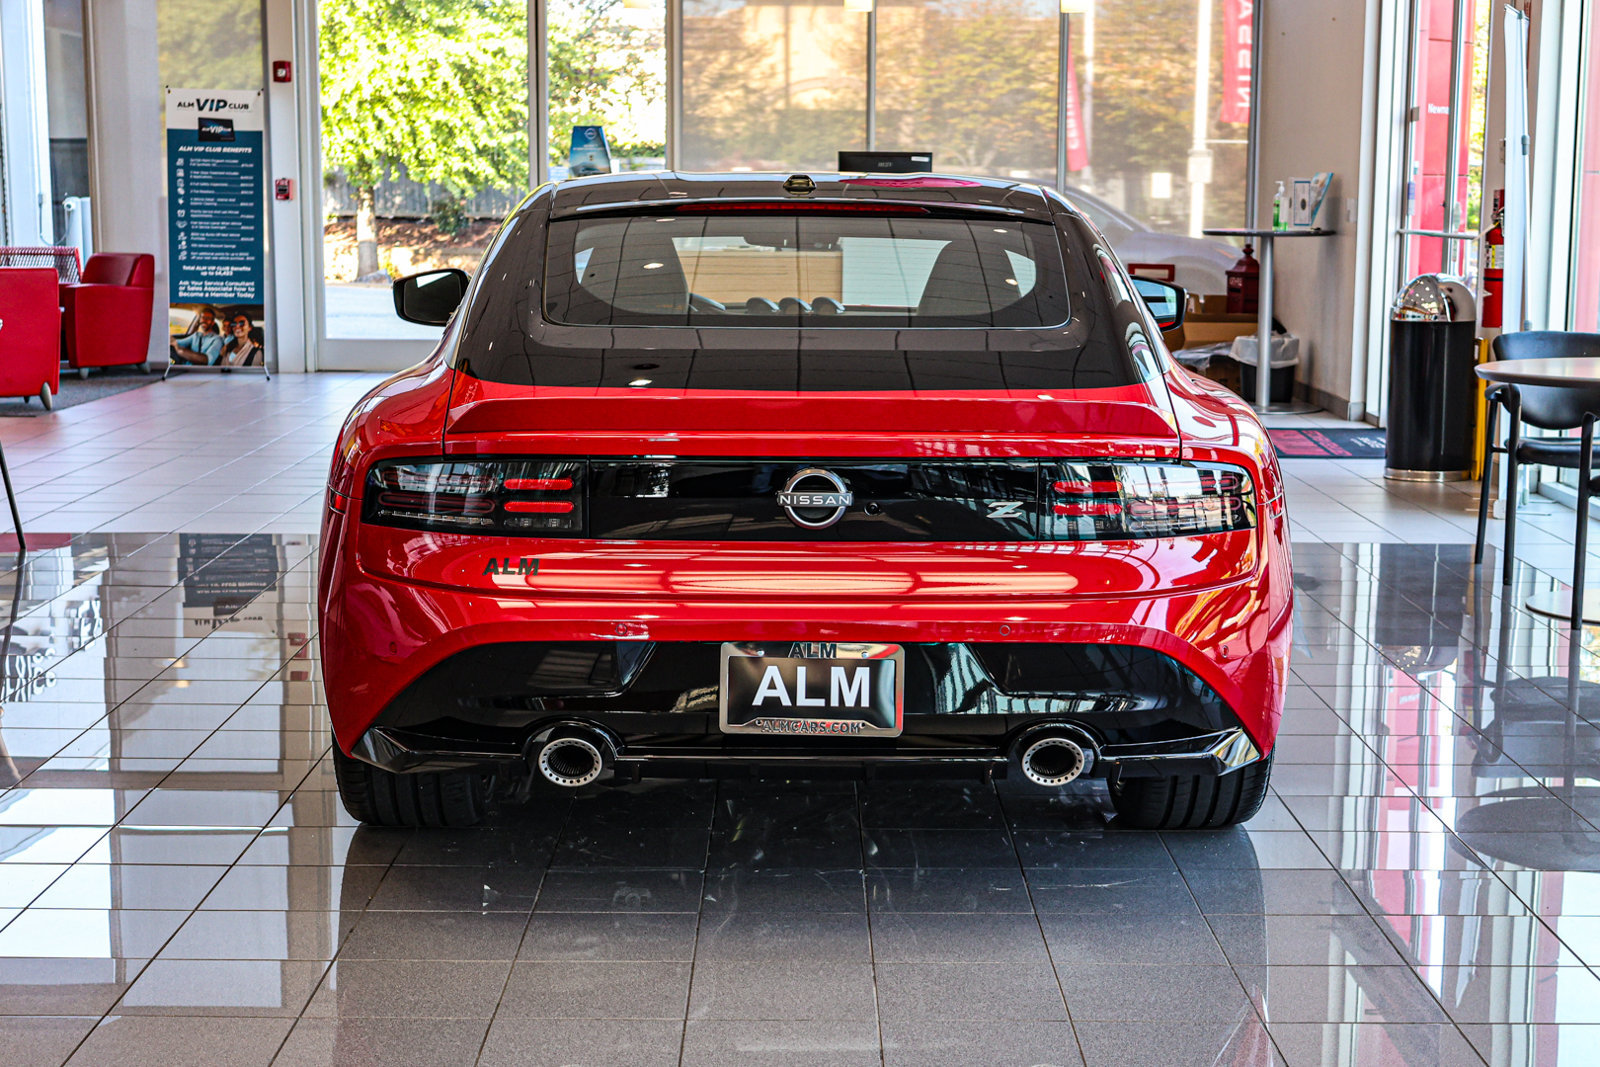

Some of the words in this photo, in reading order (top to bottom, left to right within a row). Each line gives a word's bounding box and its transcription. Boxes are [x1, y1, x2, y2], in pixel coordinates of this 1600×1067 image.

[196, 98, 228, 112] VIP
[779, 495, 850, 505] NISSAN
[986, 501, 1024, 519] Z
[482, 557, 540, 576] ALM
[787, 641, 838, 659] ALM
[751, 665, 871, 708] ALM
[760, 719, 862, 734] ALMCARS.COM
